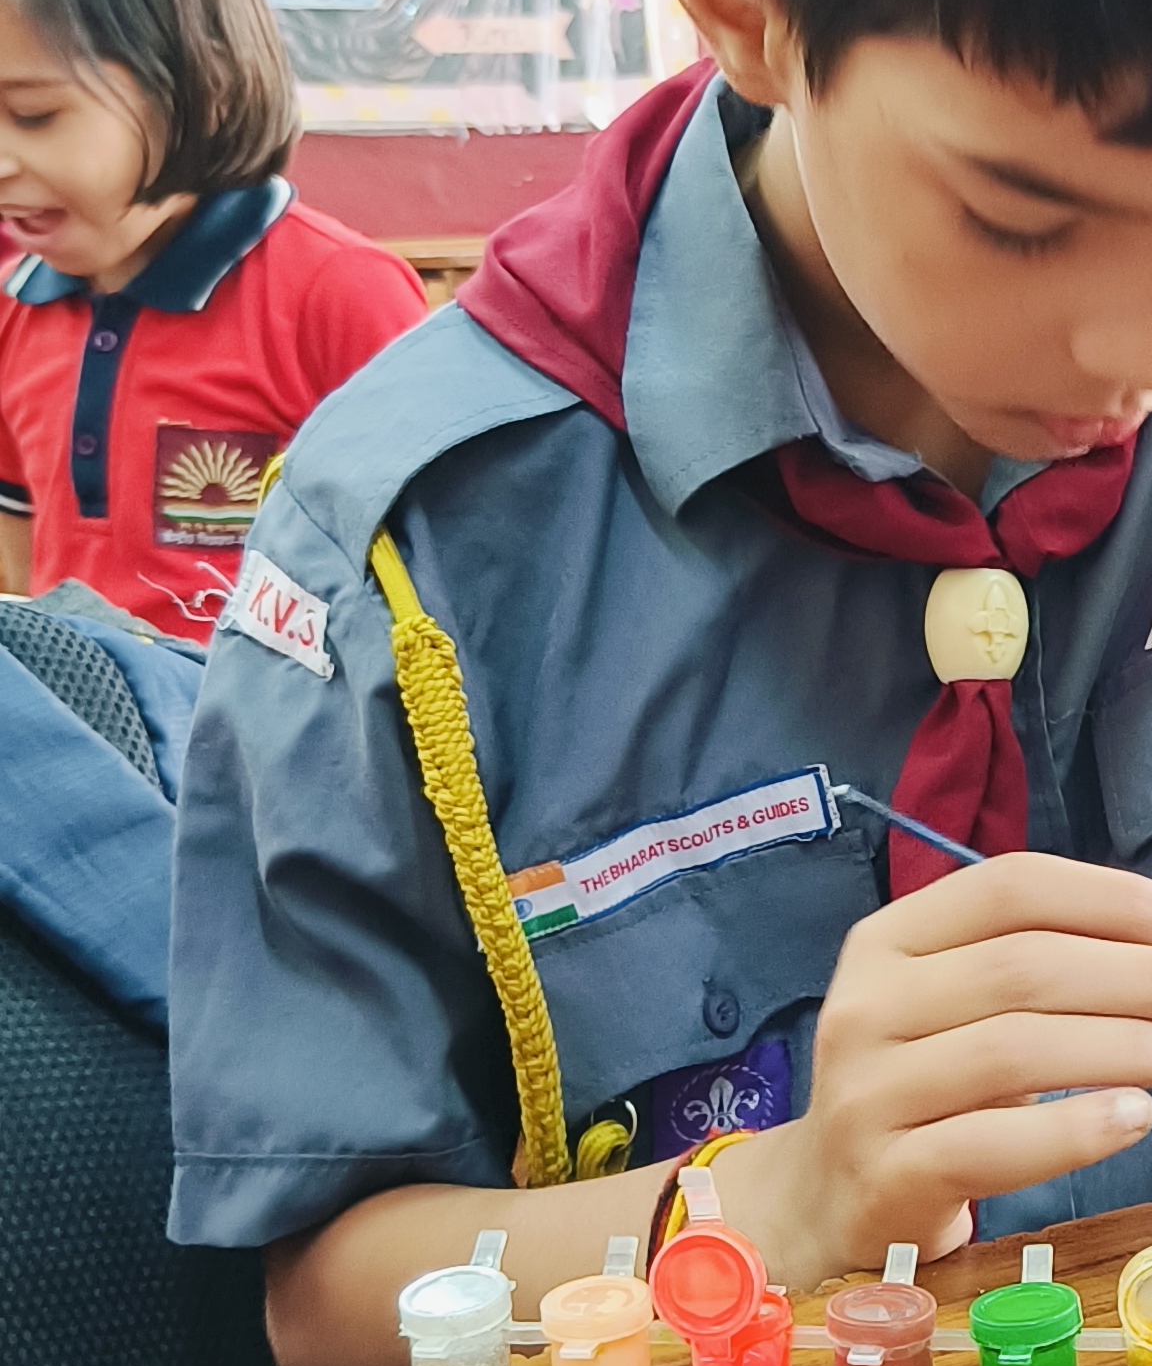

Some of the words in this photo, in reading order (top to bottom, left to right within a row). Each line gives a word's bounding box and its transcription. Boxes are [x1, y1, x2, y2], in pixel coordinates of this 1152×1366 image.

[664, 819, 734, 853] SCOUTS
[736, 814, 751, 830] &
[751, 796, 810, 825] GUIDES
